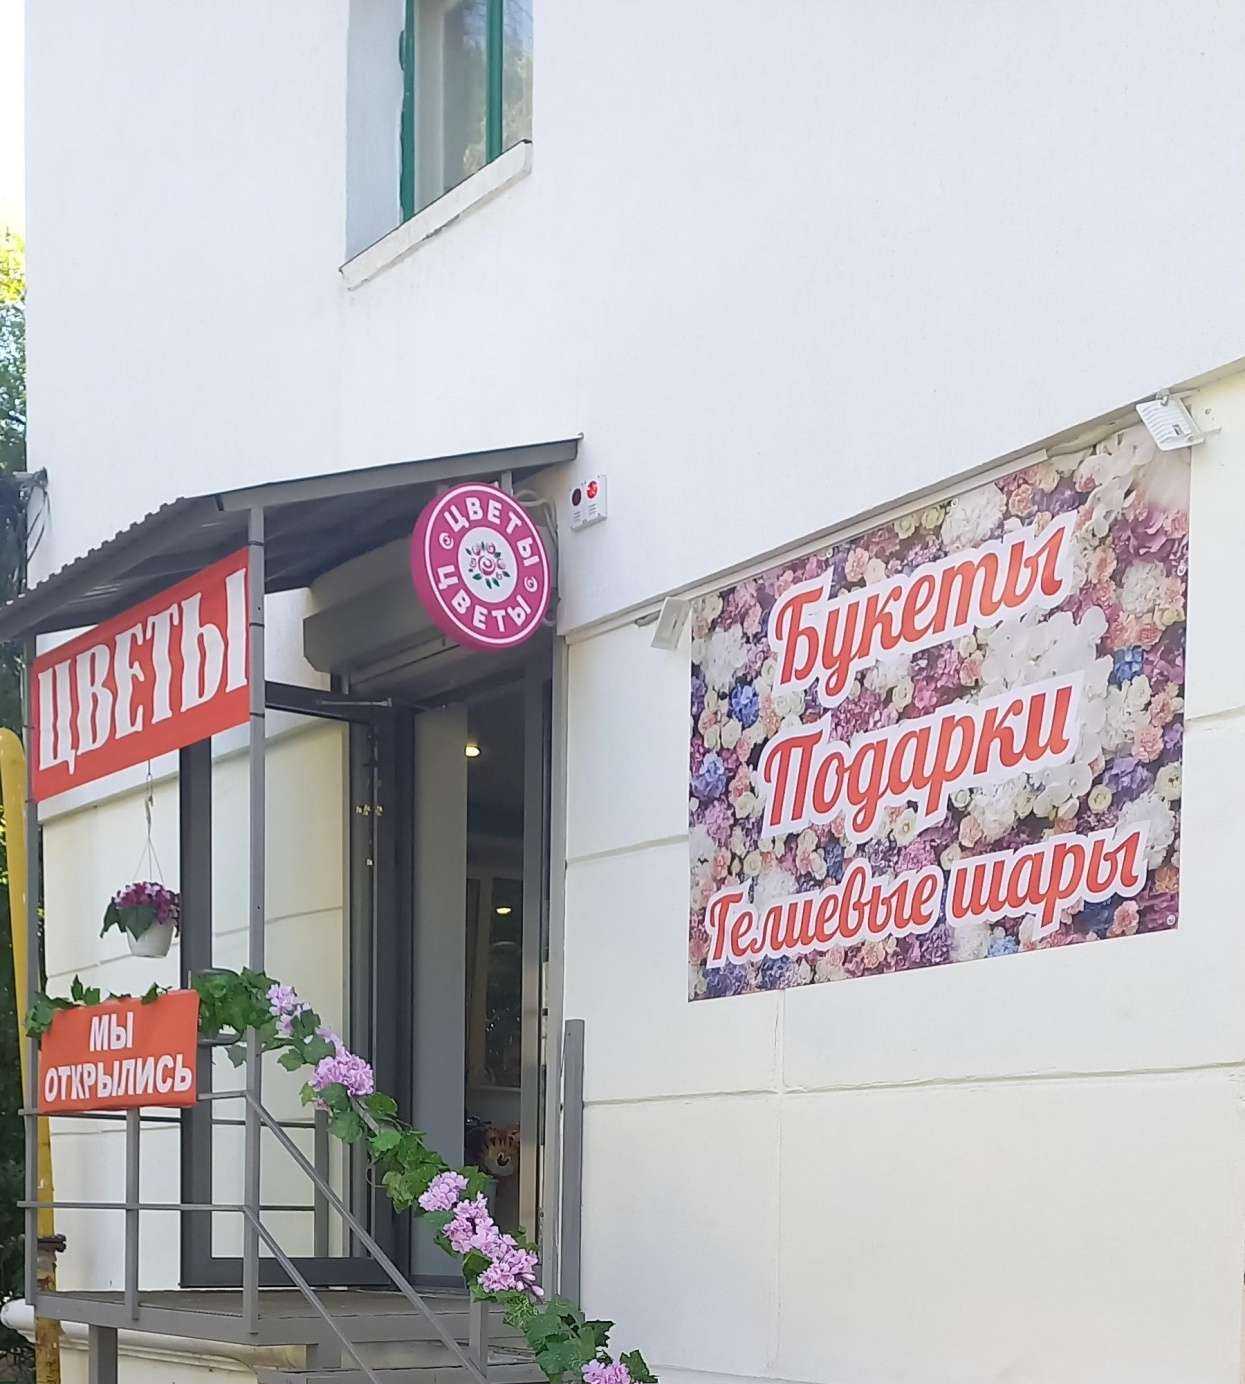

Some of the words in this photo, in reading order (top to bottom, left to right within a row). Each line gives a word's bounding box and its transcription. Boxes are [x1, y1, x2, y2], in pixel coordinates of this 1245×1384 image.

[444, 497, 540, 567] ЦВЕТЫ
[437, 565, 532, 633] ЦВЕТЫ
[774, 525, 1067, 698] Букеты
[37, 567, 248, 776] ЦВЕТЫ
[764, 686, 1074, 832] Подарки
[708, 866, 941, 961] Гелиевые
[952, 830, 1141, 928] шары
[44, 1053, 193, 1103] ОТКРЫЛИСЬ
[89, 1011, 134, 1052] МЫ
